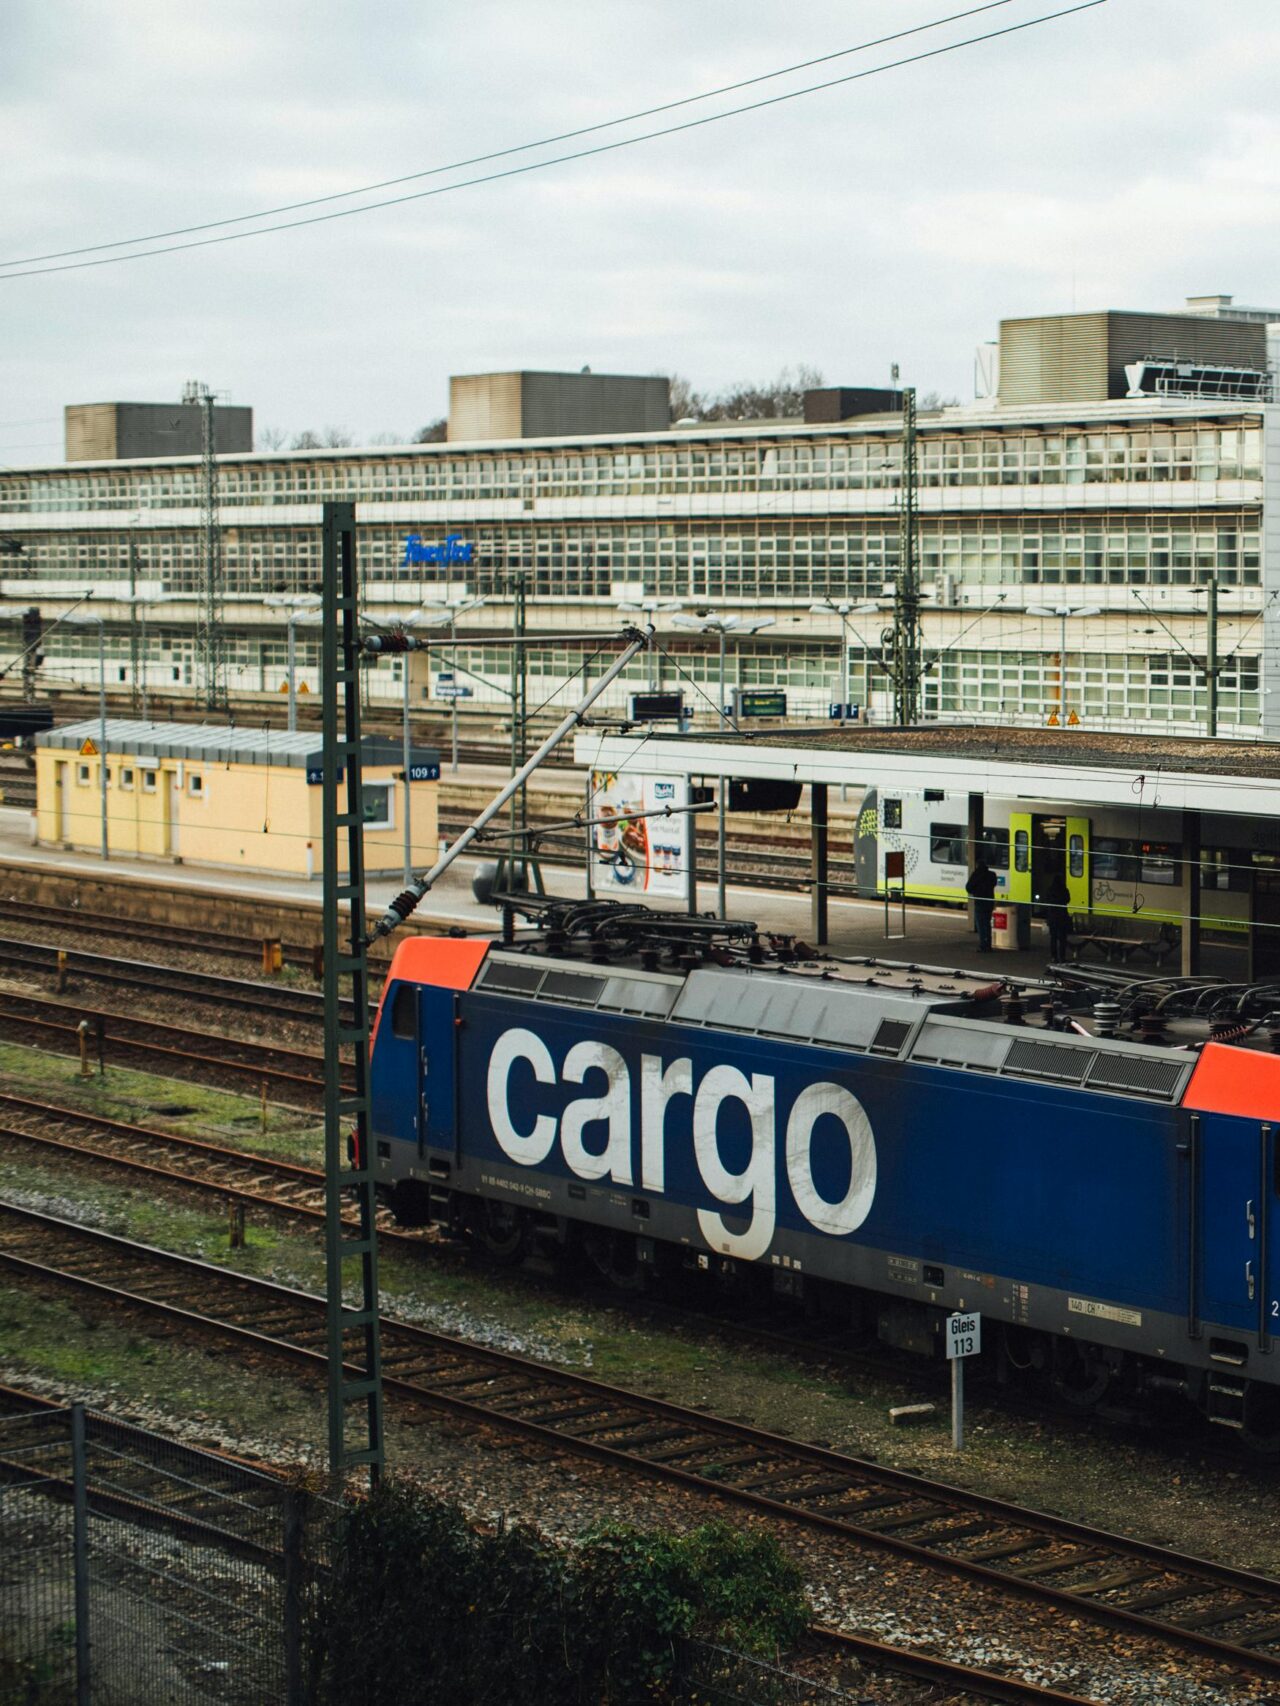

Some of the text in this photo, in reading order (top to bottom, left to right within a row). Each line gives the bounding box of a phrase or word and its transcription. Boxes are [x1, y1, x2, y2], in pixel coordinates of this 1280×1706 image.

[831, 704, 838, 716] F
[851, 704, 858, 716] F
[411, 767, 428, 779] 109
[487, 1027, 878, 1262] cargo
[1271, 1300, 1279, 1316] 2
[951, 1318, 976, 1335] Gleis
[953, 1337, 974, 1355] 113
